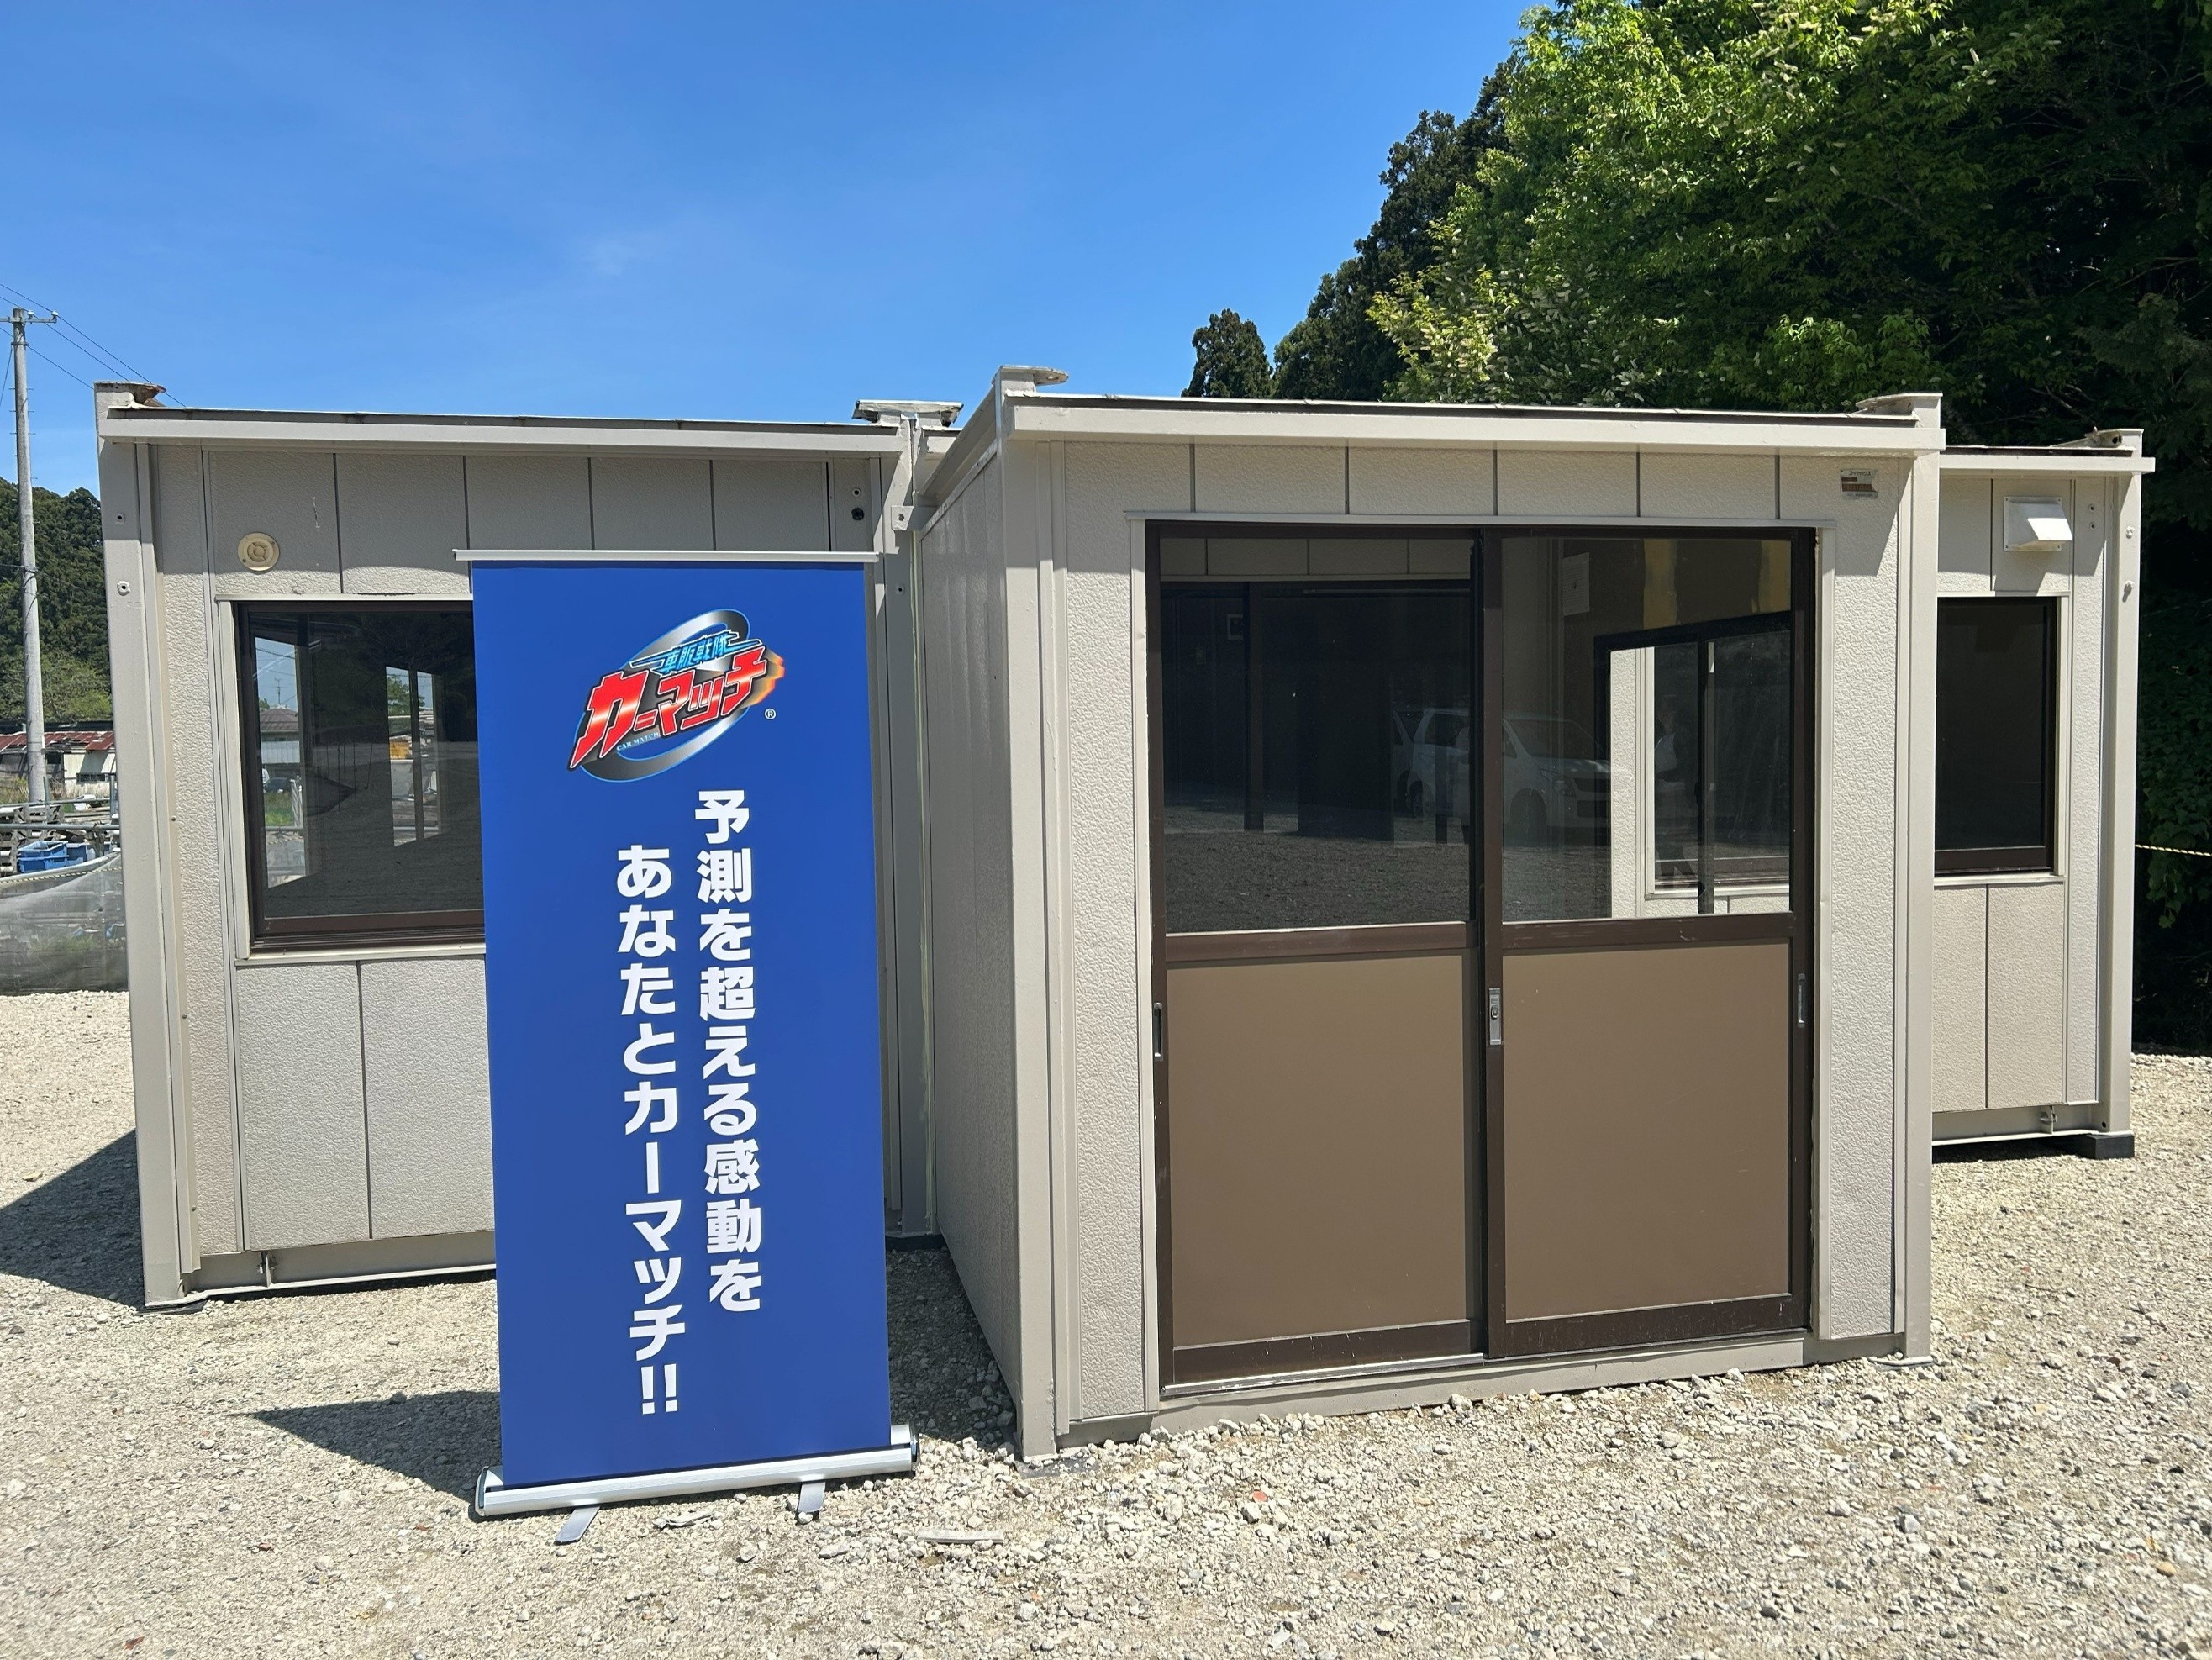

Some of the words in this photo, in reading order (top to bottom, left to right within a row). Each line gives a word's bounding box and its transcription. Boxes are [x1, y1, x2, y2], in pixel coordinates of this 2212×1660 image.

[569, 645, 768, 768] カーマッチ
[616, 740, 632, 751] CAR
[694, 789, 761, 1312] 予測を超える感動を
